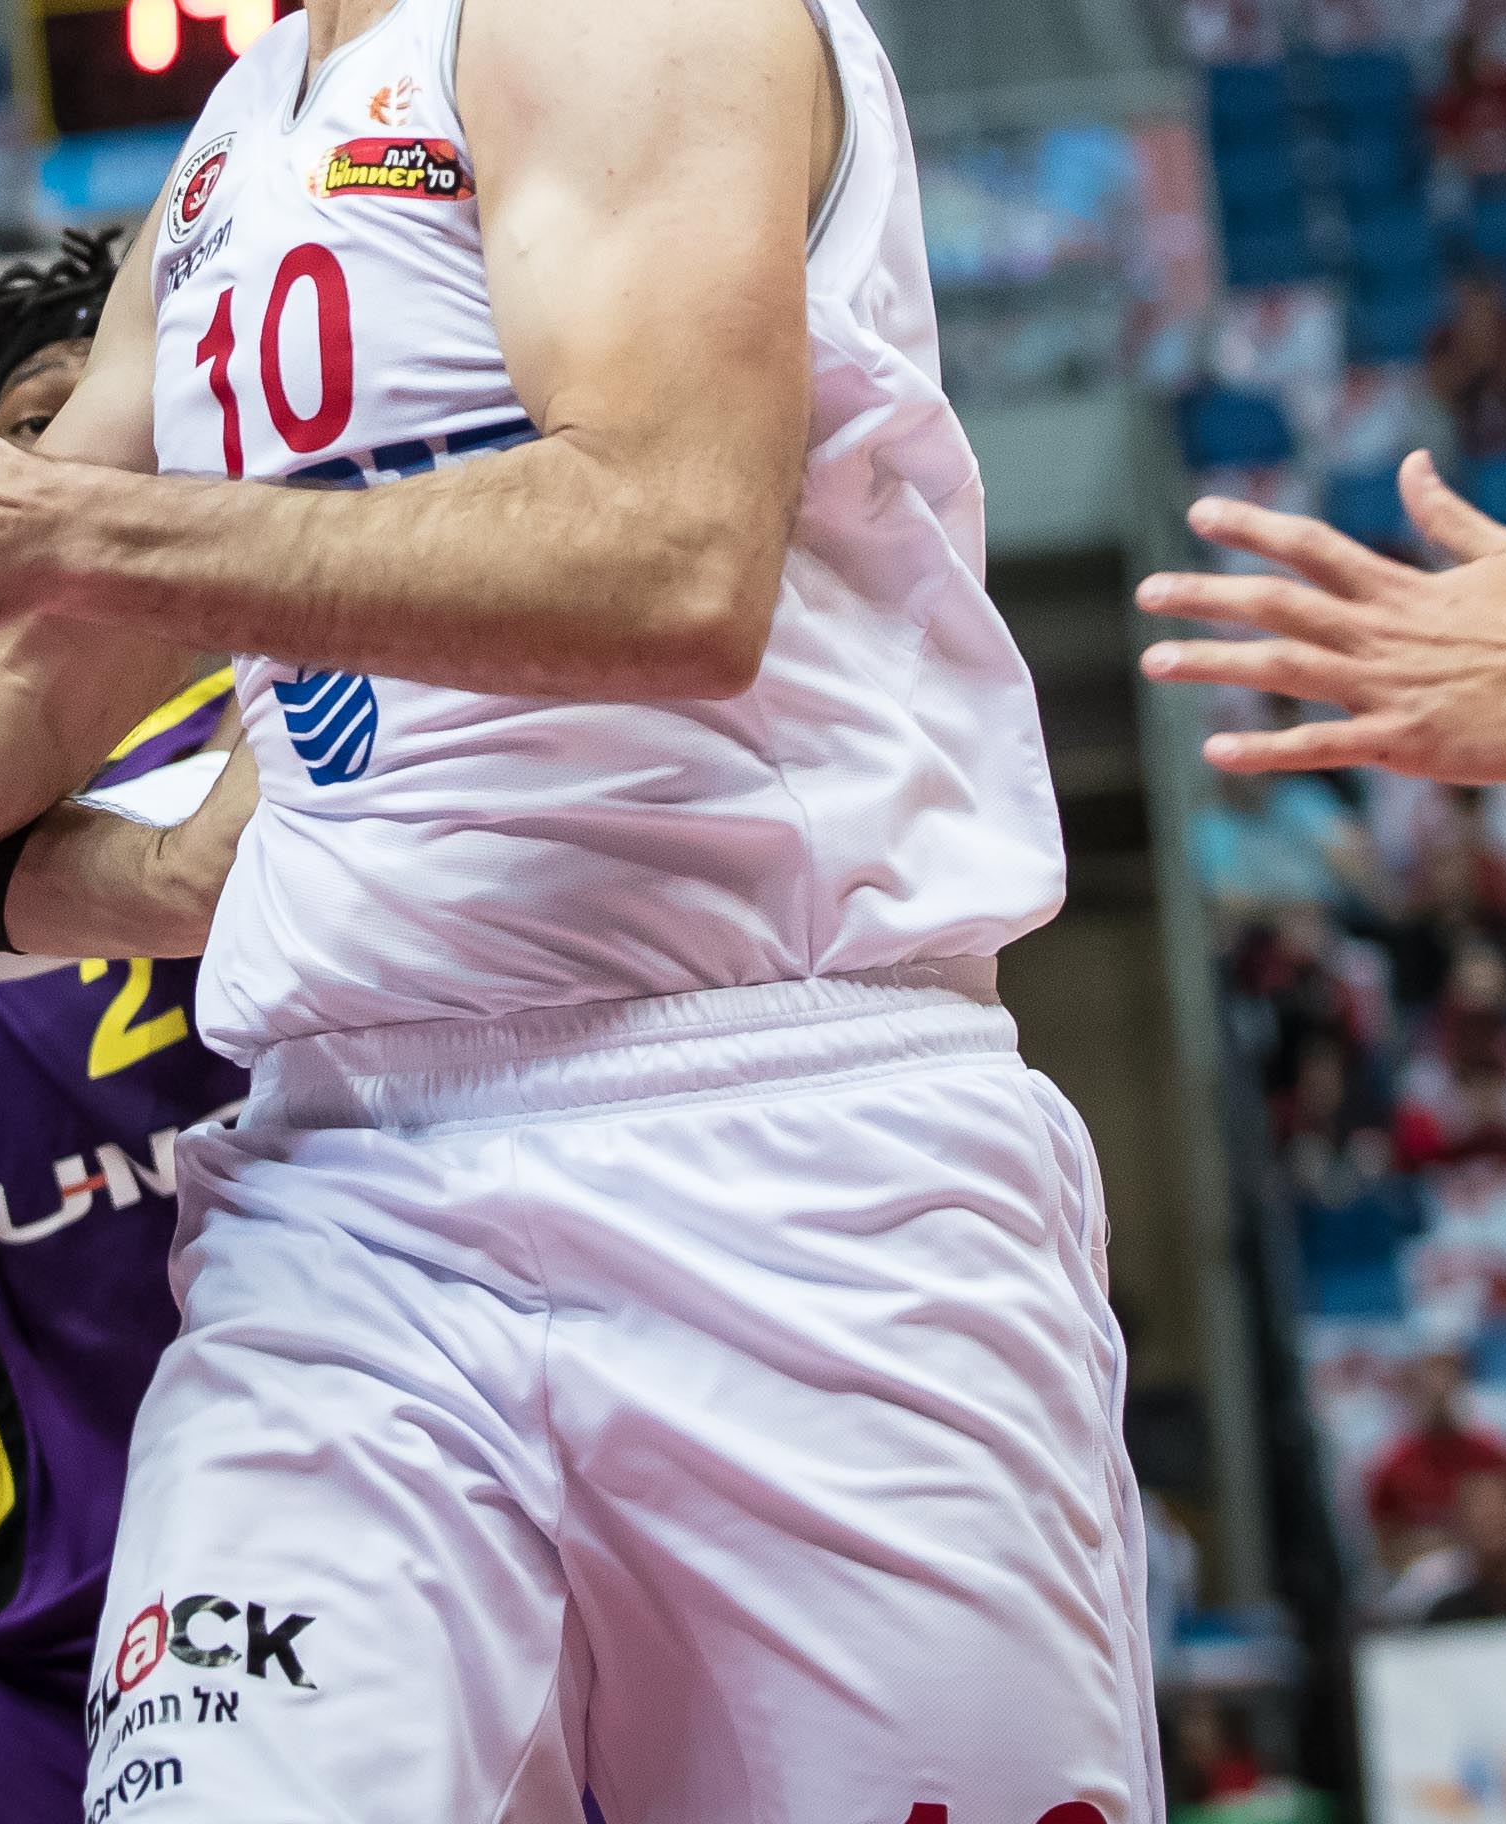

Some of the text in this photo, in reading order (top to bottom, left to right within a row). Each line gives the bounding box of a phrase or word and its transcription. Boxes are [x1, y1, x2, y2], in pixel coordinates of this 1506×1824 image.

[383, 144, 427, 169] ליגת
[426, 161, 456, 190] סל
[196, 242, 354, 481] 10
[79, 957, 188, 1080] 2
[193, 1685, 239, 1723] אל
